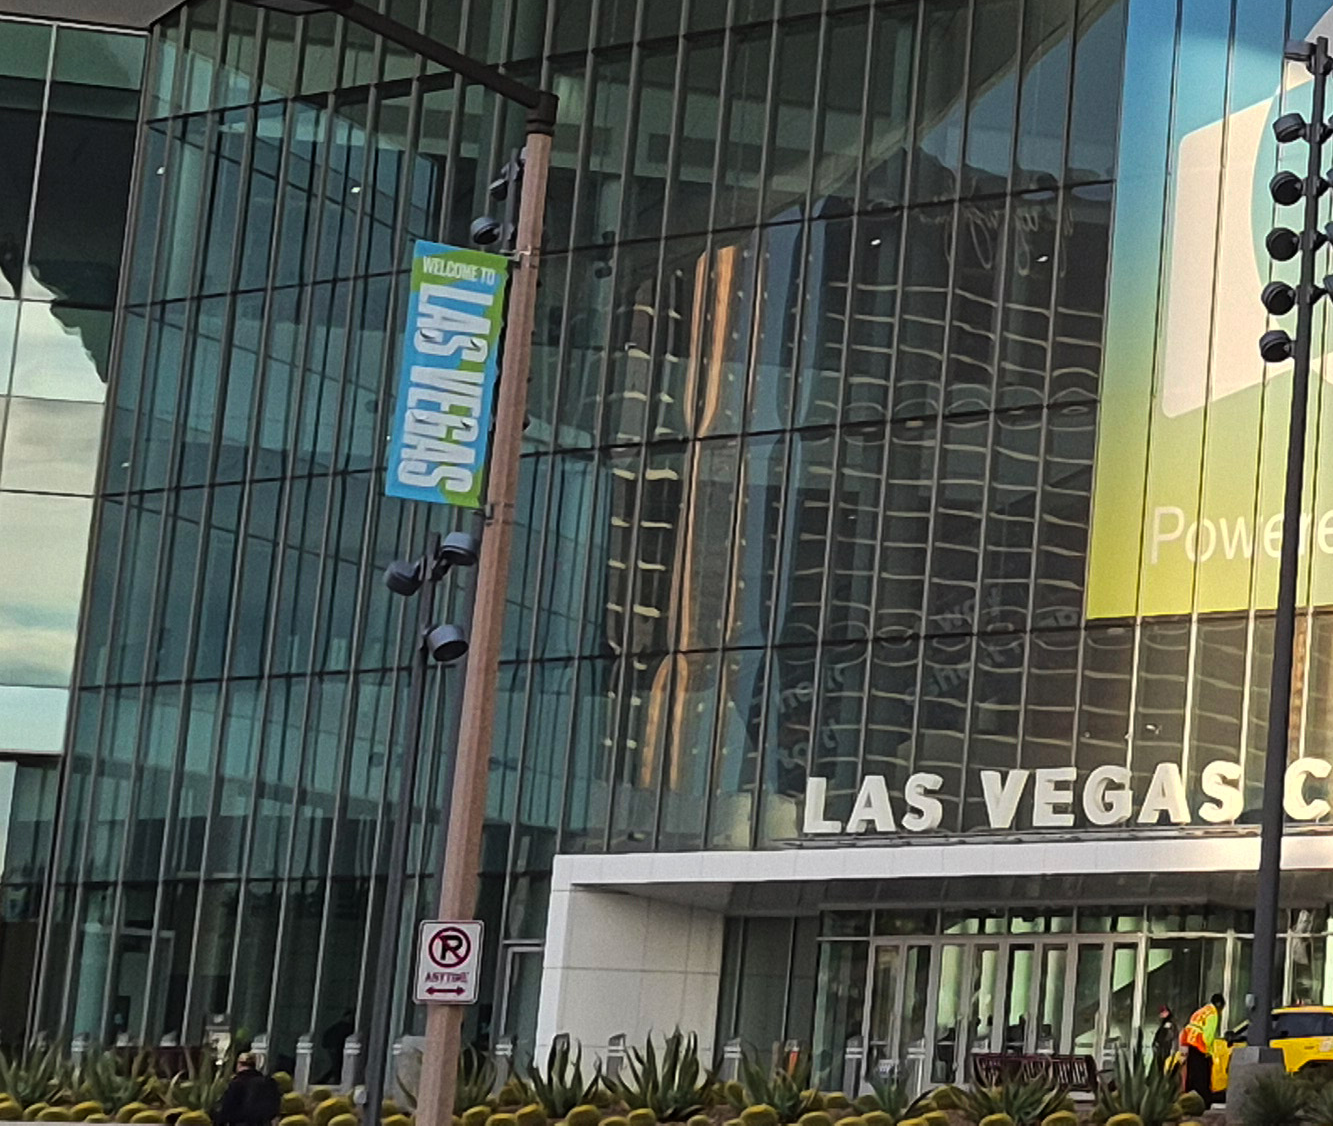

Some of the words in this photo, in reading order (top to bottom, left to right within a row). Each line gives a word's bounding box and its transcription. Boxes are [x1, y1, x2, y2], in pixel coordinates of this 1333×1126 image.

[423, 256, 478, 282] WELCOME
[481, 267, 495, 286] TO
[414, 282, 494, 362] LAS
[399, 365, 485, 493] VEGAS
[803, 772, 944, 834] LAS
[980, 760, 1245, 828] VEGAS
